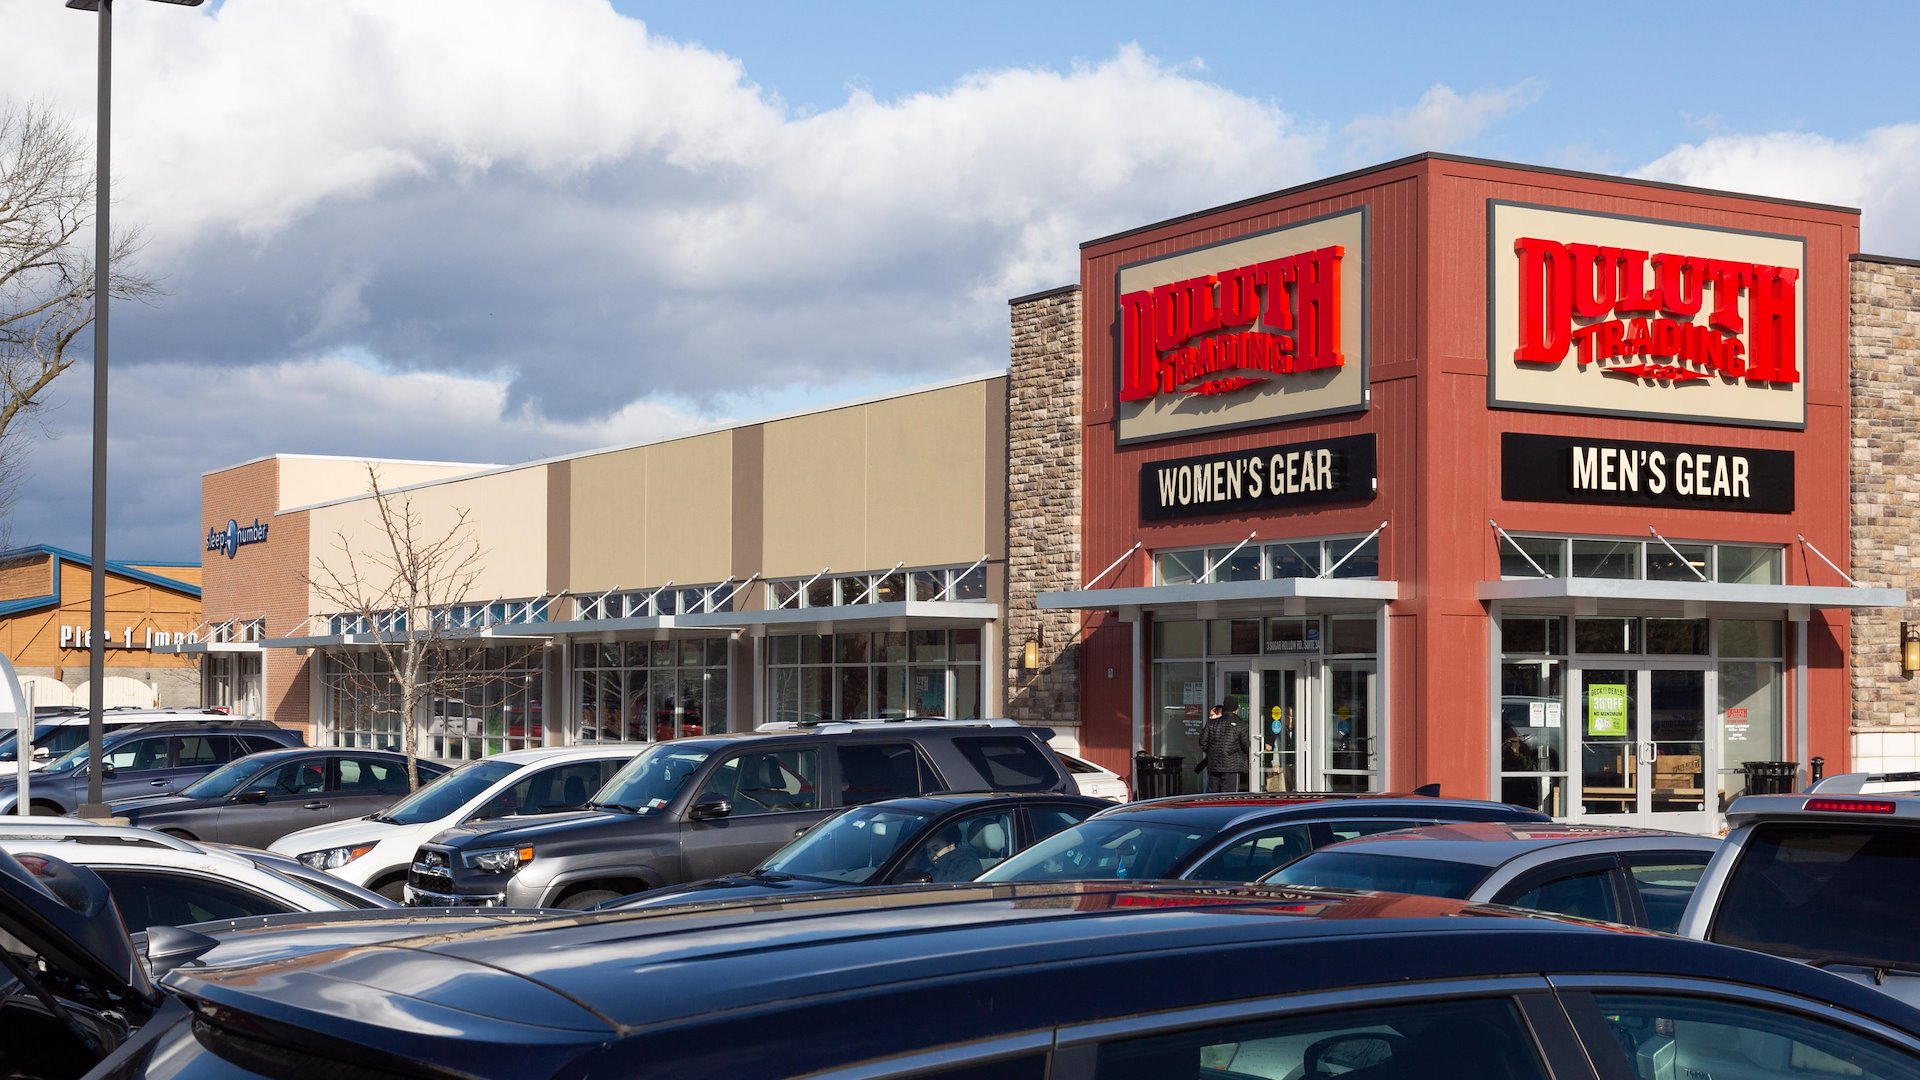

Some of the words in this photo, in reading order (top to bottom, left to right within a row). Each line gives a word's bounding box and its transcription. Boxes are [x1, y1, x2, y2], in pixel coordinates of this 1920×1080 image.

[1119, 245, 1345, 403] DULUTH
[1514, 237, 1800, 383] DULUTH
[1159, 331, 1296, 394] TRADING
[1572, 318, 1746, 378] TRADING
[1157, 456, 1263, 507] WOMEN'S
[1270, 448, 1333, 497] GEAR
[1572, 446, 1667, 494] MEN'S
[1675, 452, 1750, 498] GEAR
[206, 526, 228, 555] sleep
[237, 518, 269, 546] number
[123, 626, 132, 648] 1
[1607, 697, 1623, 710] OFF
